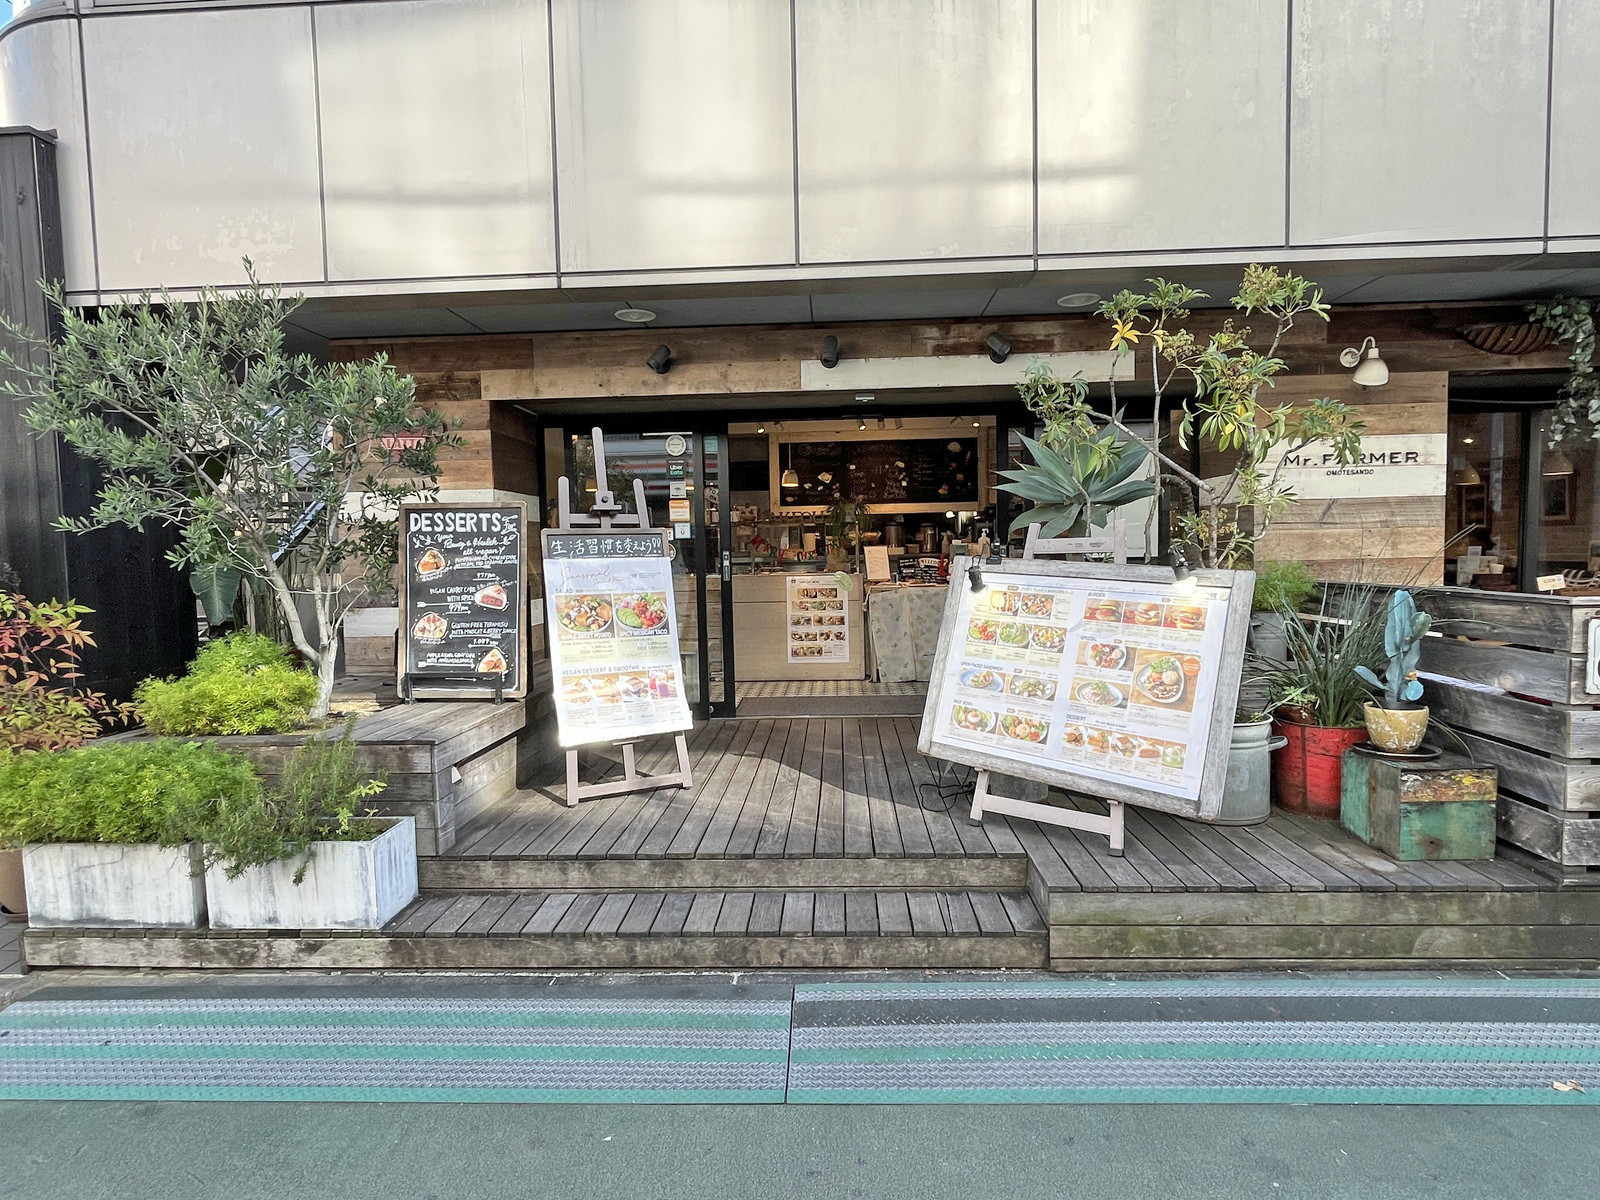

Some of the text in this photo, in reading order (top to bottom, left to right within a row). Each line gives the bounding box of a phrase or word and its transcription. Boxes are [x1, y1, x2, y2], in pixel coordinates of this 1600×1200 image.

[1284, 454, 1318, 467] Mr.
[409, 512, 502, 532] DESSERTS
[561, 668, 582, 676] VEGAN
[582, 666, 607, 674] DESSERT
[613, 664, 640, 672] SMOOTHIE
[1065, 713, 1087, 722] DESSERT
